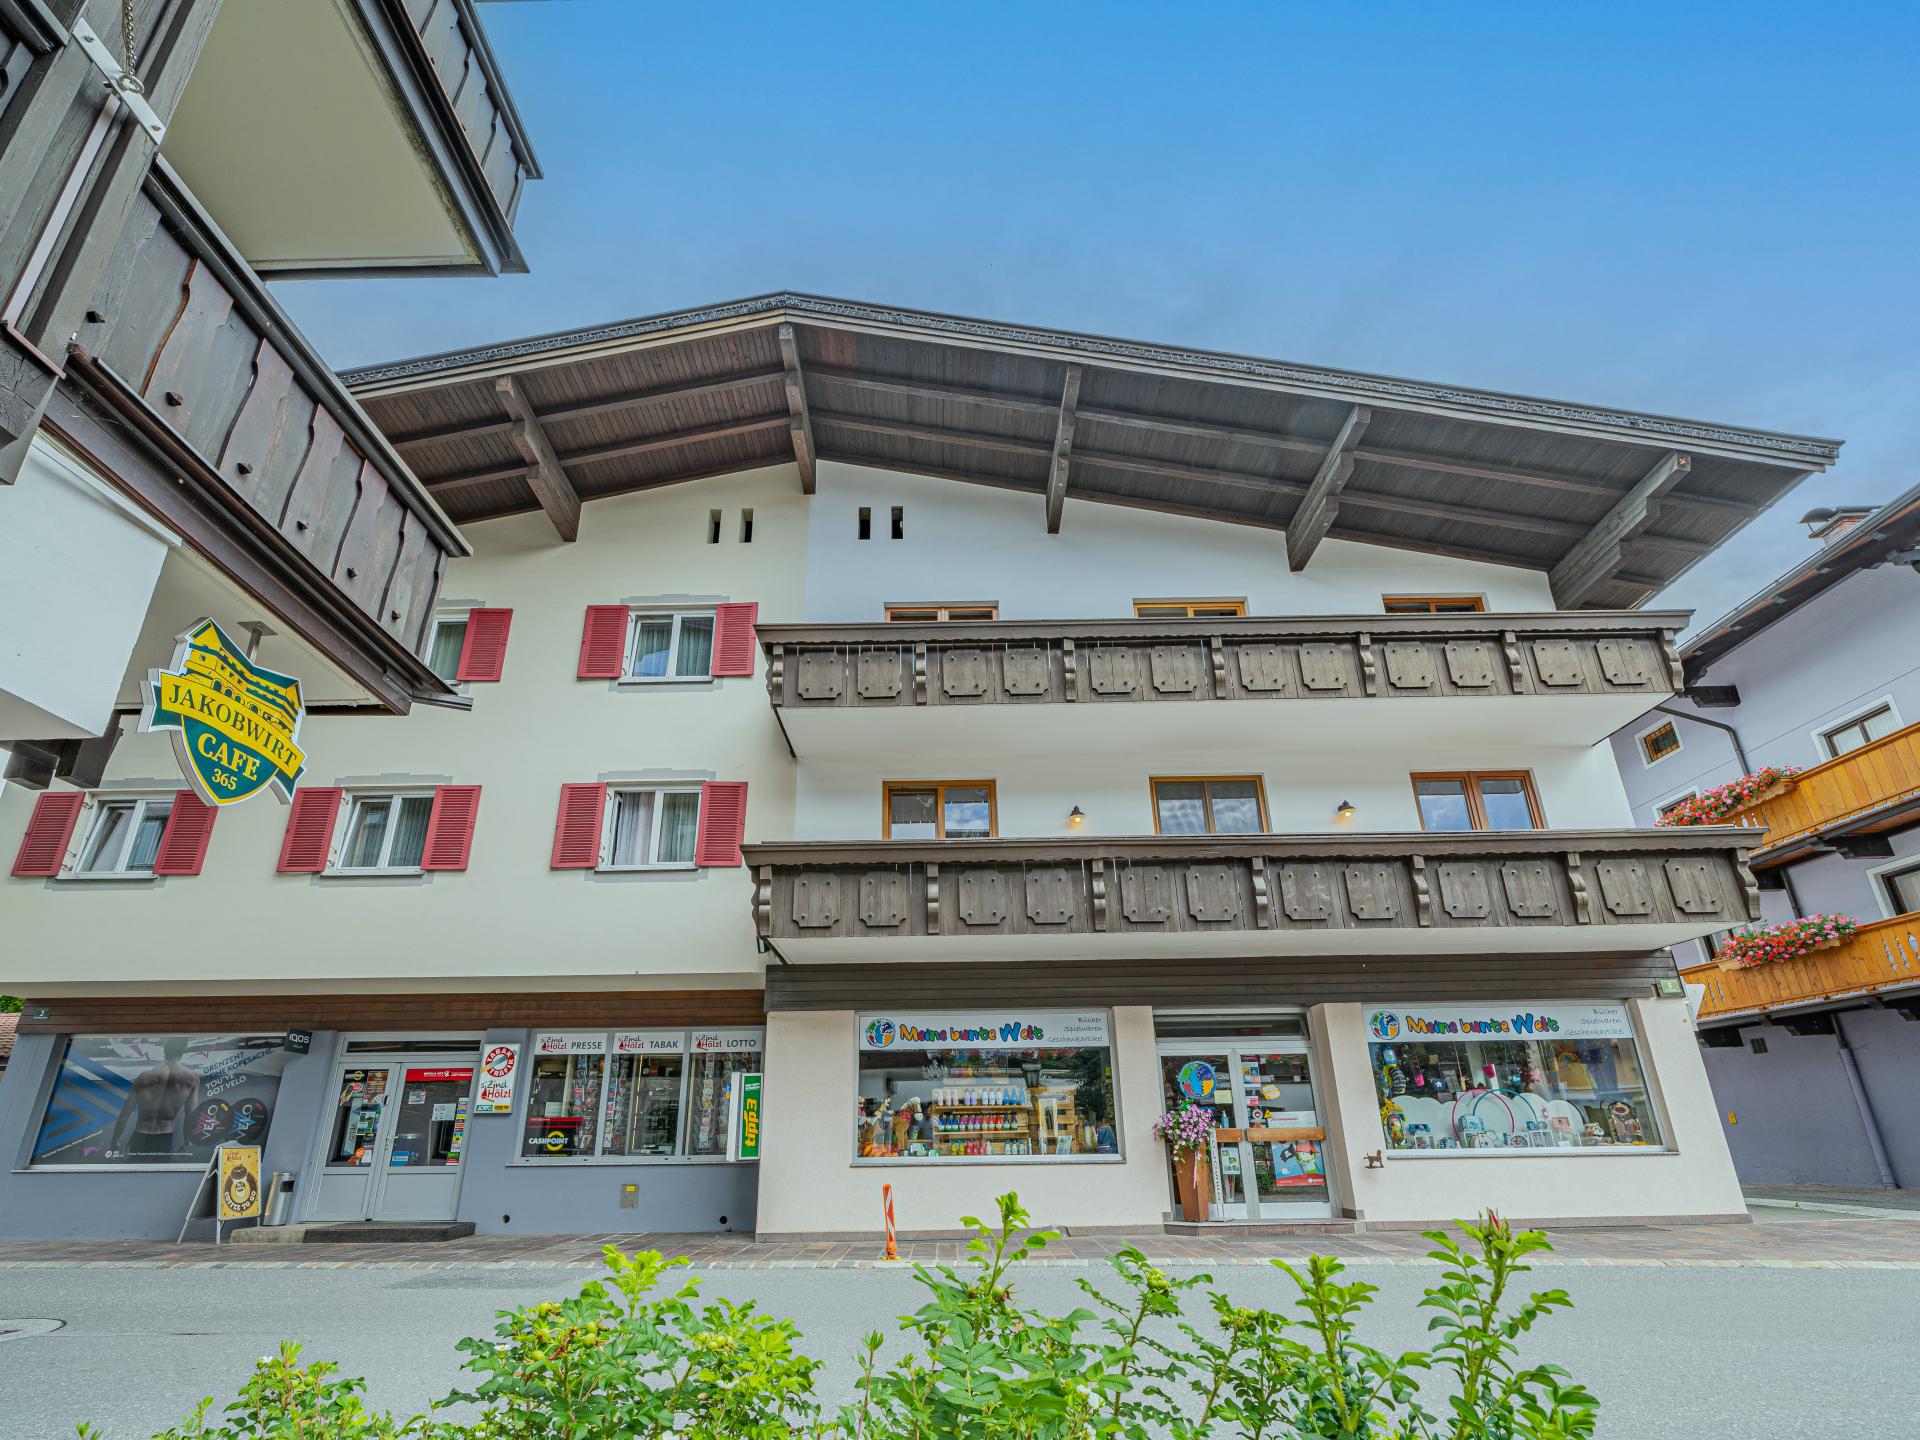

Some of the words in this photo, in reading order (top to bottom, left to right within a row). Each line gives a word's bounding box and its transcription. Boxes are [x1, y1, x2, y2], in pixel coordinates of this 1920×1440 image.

[168, 684, 298, 767] JAKOBWIRT
[197, 733, 260, 782] CAFE
[211, 768, 238, 791] 365
[1406, 1015, 1458, 1034] Meine
[1459, 1018, 1510, 1034] bunte
[1511, 1012, 1560, 1034] Welt
[1580, 1018, 1622, 1026] Spielwaren
[900, 1023, 948, 1042] Meine
[949, 1026, 997, 1042] bunte
[999, 1021, 1044, 1042] Welt
[1063, 1025, 1103, 1033] Spielwaren
[1564, 1028, 1625, 1036] Geschenkartikel
[289, 1033, 310, 1044] IQOS
[701, 1040, 723, 1048] Hölzl
[726, 1039, 757, 1048] LOTTO
[1047, 1035, 1104, 1043] Geschenkartikel
[546, 1042, 567, 1050] Hölzl
[571, 1041, 603, 1050] PRESSE
[624, 1041, 645, 1049] Hölzl
[649, 1040, 679, 1049] TABAK
[227, 1047, 273, 1072] KOPFSACHE
[487, 1048, 513, 1062] TABAK
[489, 1059, 514, 1077] TRAFIK
[205, 1073, 235, 1090] YOU'VE
[206, 1085, 224, 1097] GOT
[225, 1076, 246, 1089] VELO
[487, 1088, 512, 1098] Hölzl
[743, 1098, 759, 1147] tipp3
[528, 1137, 569, 1145] CASHPOINT
[224, 1191, 241, 1210] COFFEE
[241, 1202, 251, 1210] TO
[249, 1190, 257, 1201] GO
